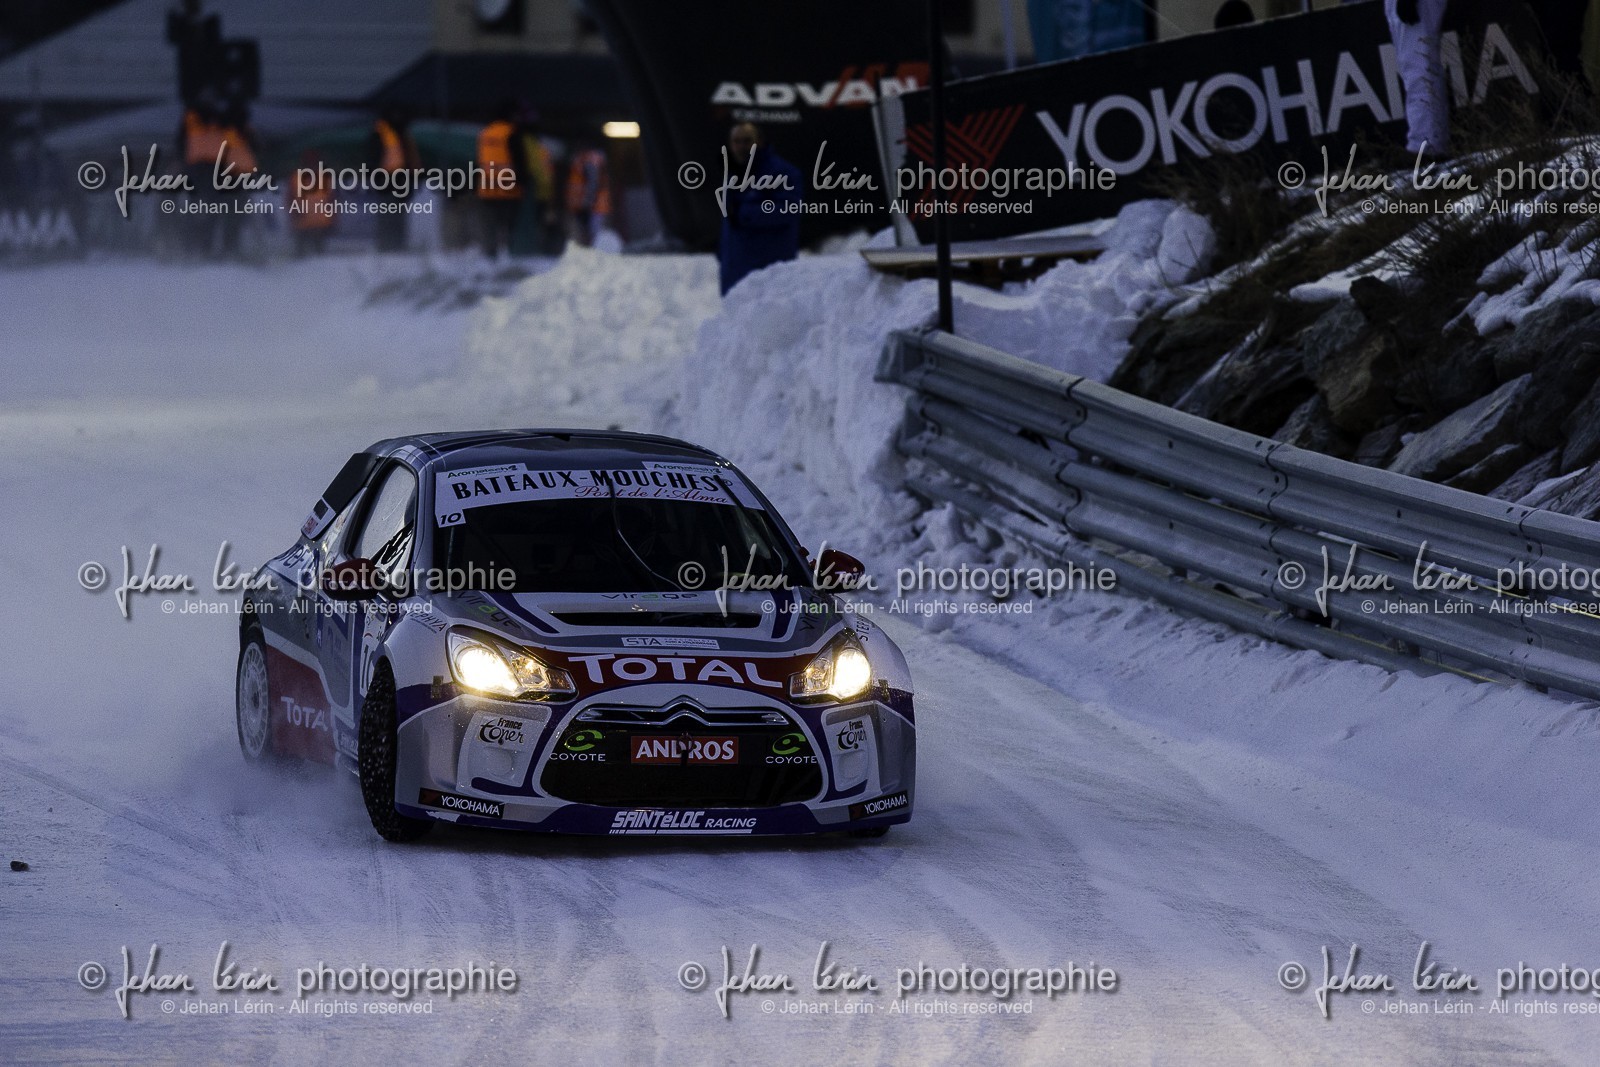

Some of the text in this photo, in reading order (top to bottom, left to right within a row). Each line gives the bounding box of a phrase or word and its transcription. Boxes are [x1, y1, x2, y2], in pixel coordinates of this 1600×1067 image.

[709, 74, 924, 108] ADVAN
[1036, 22, 1540, 184] YOKOHAMA
[627, 486, 648, 498] de
[440, 512, 462, 525] 10
[626, 637, 663, 647] STA
[568, 653, 783, 688] TOTAL
[549, 752, 606, 763] COYOTE
[636, 739, 735, 761] ANDROS
[765, 755, 818, 764] COYOTE
[441, 795, 500, 816] YOKOHAMA
[864, 794, 908, 814] YOKOHAMA
[705, 817, 757, 828] RACING
